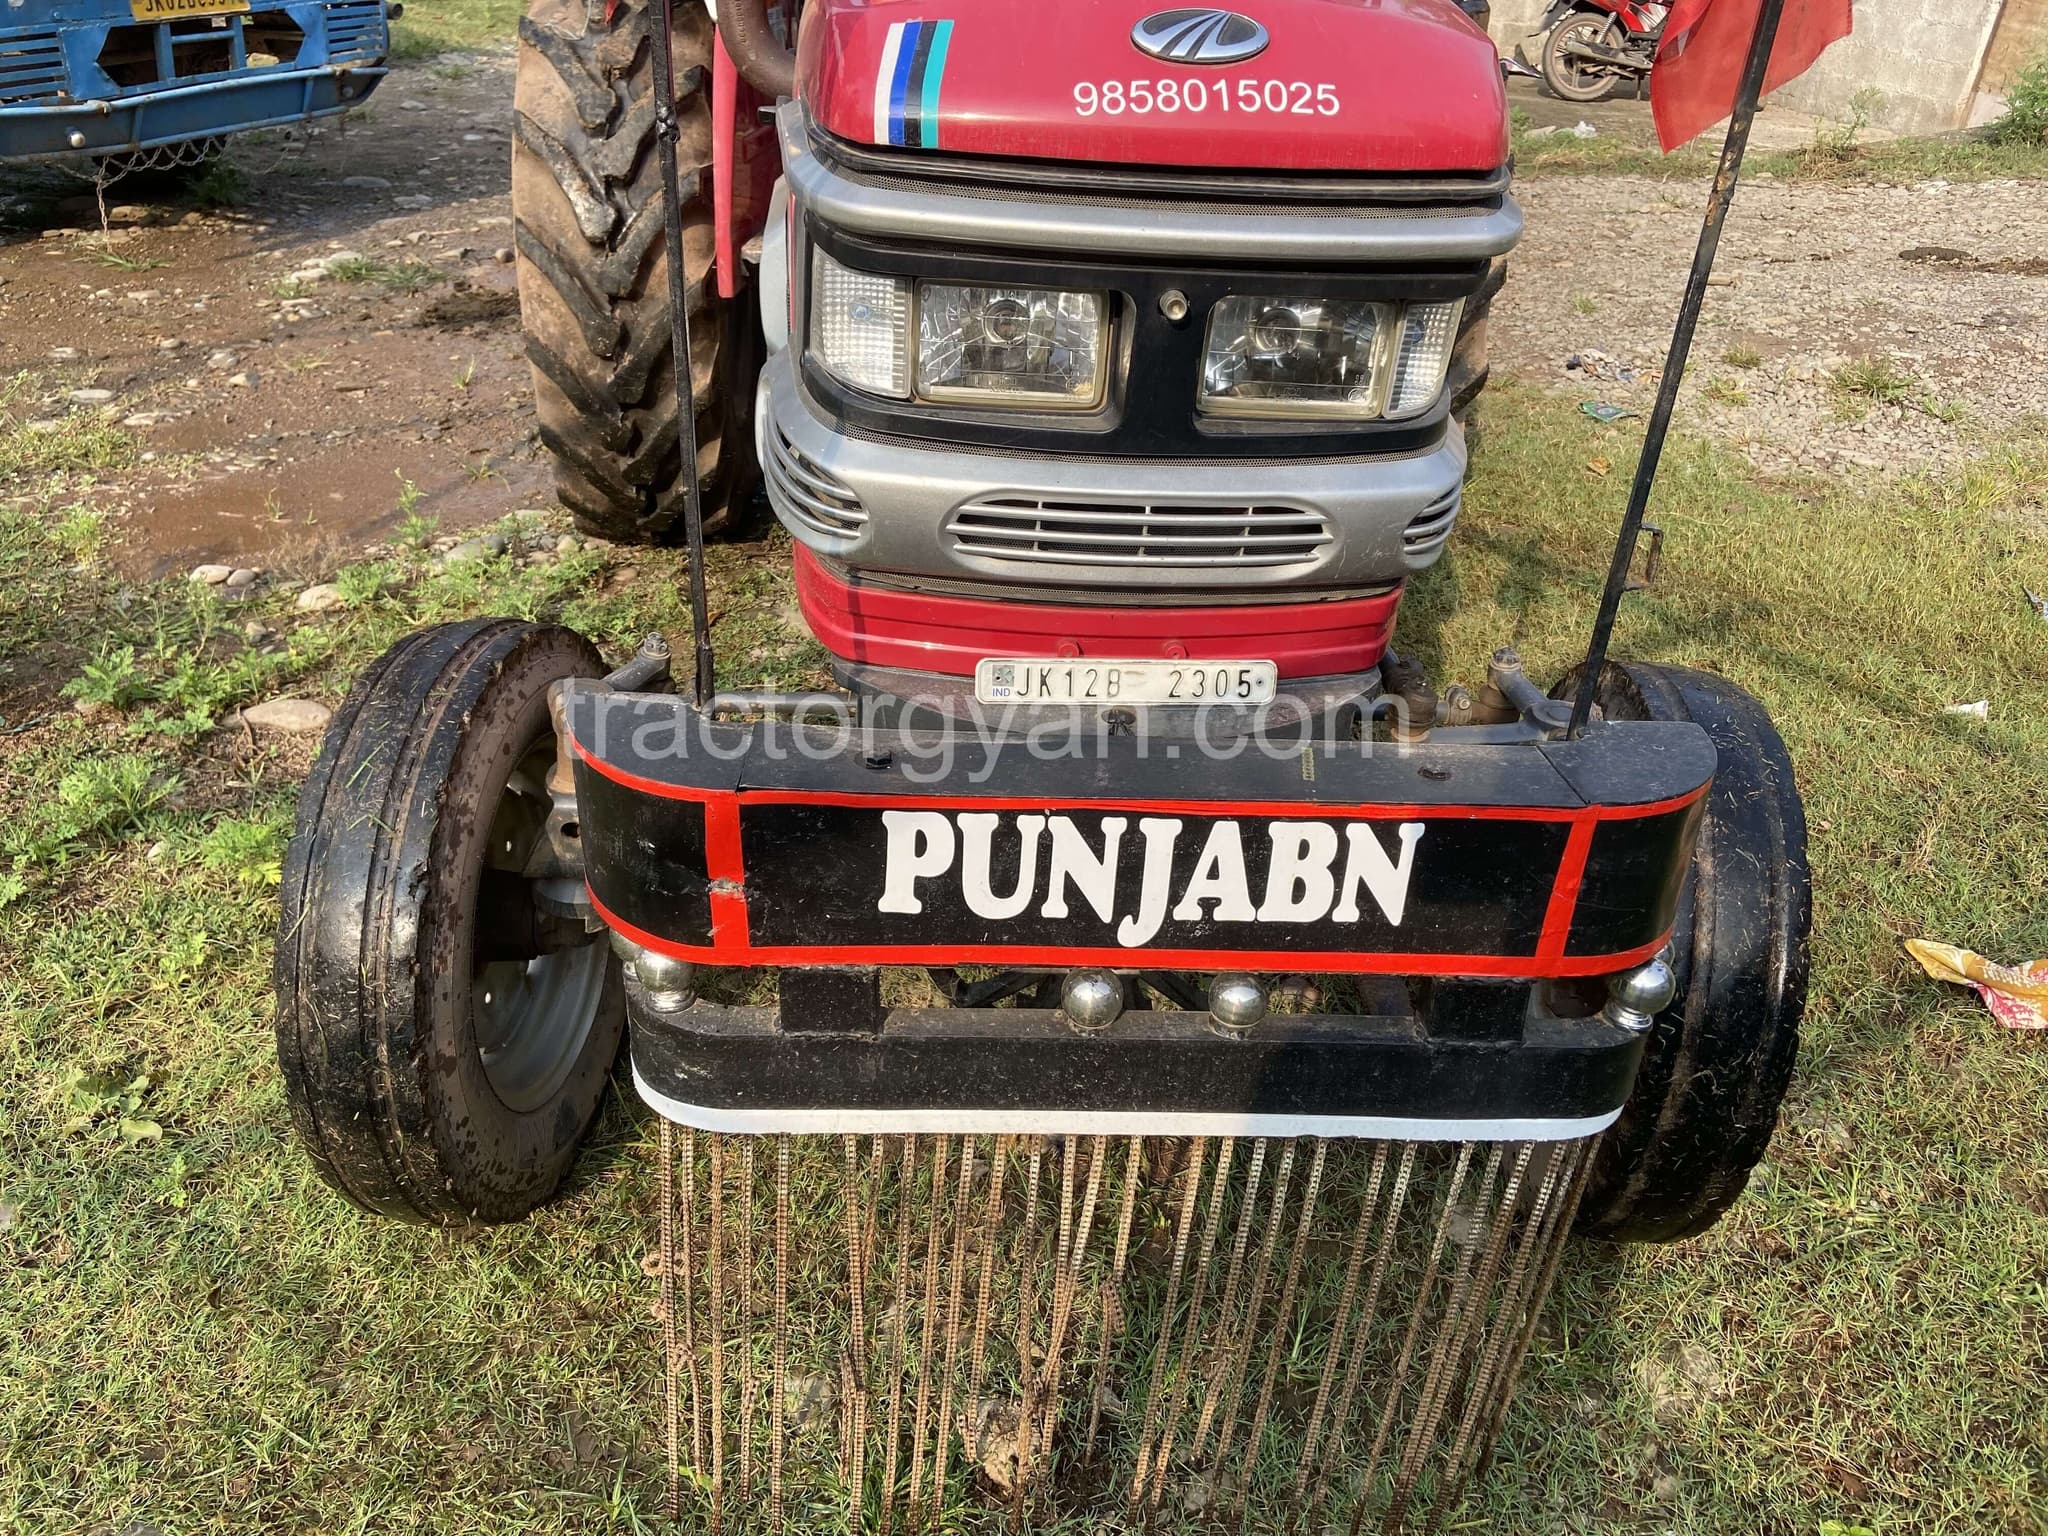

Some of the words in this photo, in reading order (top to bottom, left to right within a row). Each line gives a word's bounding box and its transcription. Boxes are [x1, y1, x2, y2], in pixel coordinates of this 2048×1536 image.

[1073, 78, 1341, 117] 9858015025
[992, 687, 1011, 697] IND
[1016, 667, 1121, 698] JK12B
[1168, 669, 1252, 698] 2305
[878, 810, 1425, 948] PUNJABN
